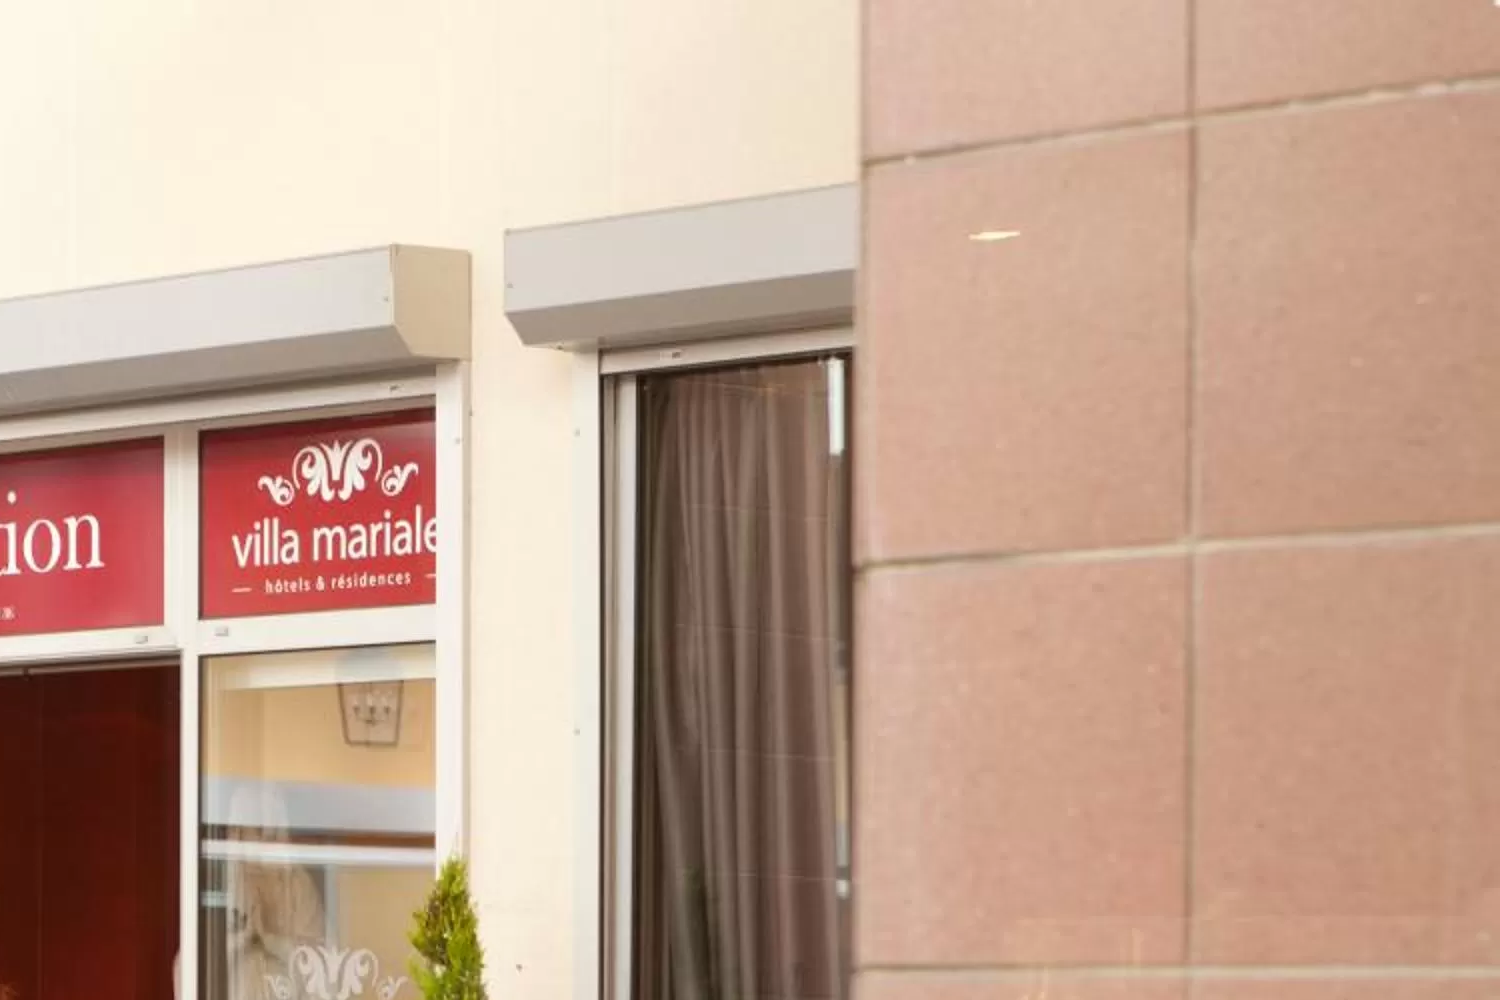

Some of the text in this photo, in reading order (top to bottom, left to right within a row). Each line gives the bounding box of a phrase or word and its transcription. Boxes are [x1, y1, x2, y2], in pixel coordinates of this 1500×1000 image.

[231, 504, 436, 568] villa mariale
[265, 572, 412, 594] hôtels & résidences
